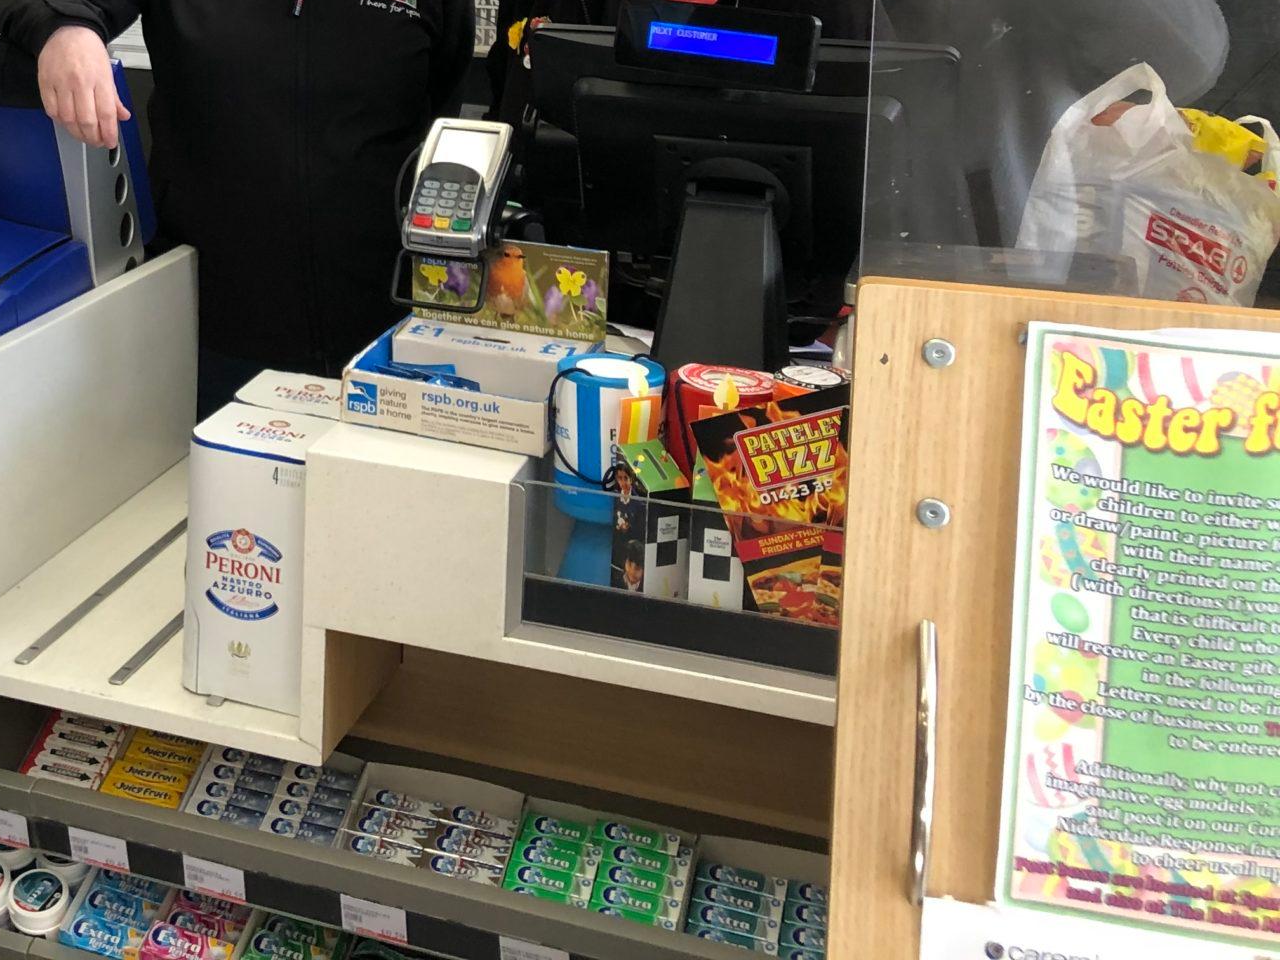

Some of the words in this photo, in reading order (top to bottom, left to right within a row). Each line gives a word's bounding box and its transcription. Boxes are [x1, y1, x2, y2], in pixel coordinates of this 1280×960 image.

[1149, 216, 1228, 272] SPAR
[408, 324, 444, 338] £1
[422, 308, 462, 324] Together
[481, 317, 498, 328] can
[500, 319, 520, 331] give
[523, 324, 555, 335] nature
[565, 329, 594, 340] home
[379, 387, 407, 401] giving
[380, 398, 408, 409] nature
[422, 391, 500, 414] rspb.org.uk
[1052, 351, 1236, 455] Easter
[348, 399, 376, 415] rspb
[386, 409, 412, 421] home
[237, 421, 305, 439] PERONI
[751, 440, 836, 483] PIZZ
[760, 484, 810, 505] 01423
[1051, 463, 1080, 483] We
[1083, 475, 1140, 495] would
[1145, 482, 1180, 501] like
[1184, 488, 1203, 503] to
[1208, 491, 1263, 509] invite
[1097, 497, 1176, 521] children
[1181, 508, 1200, 523] to
[1203, 513, 1262, 529] either
[761, 543, 793, 554] FRIDAY
[1123, 543, 1164, 561] with
[206, 551, 281, 584] PERONI
[1090, 558, 1150, 581] clearly
[1157, 570, 1228, 589] printed
[212, 581, 272, 599] AZZURRO
[222, 576, 262, 588] NASTRO
[1083, 578, 1124, 597] with
[1153, 712, 1233, 732] business
[95, 895, 135, 917] Extra
[79, 921, 120, 945] Extra
[157, 929, 201, 954] Extra
